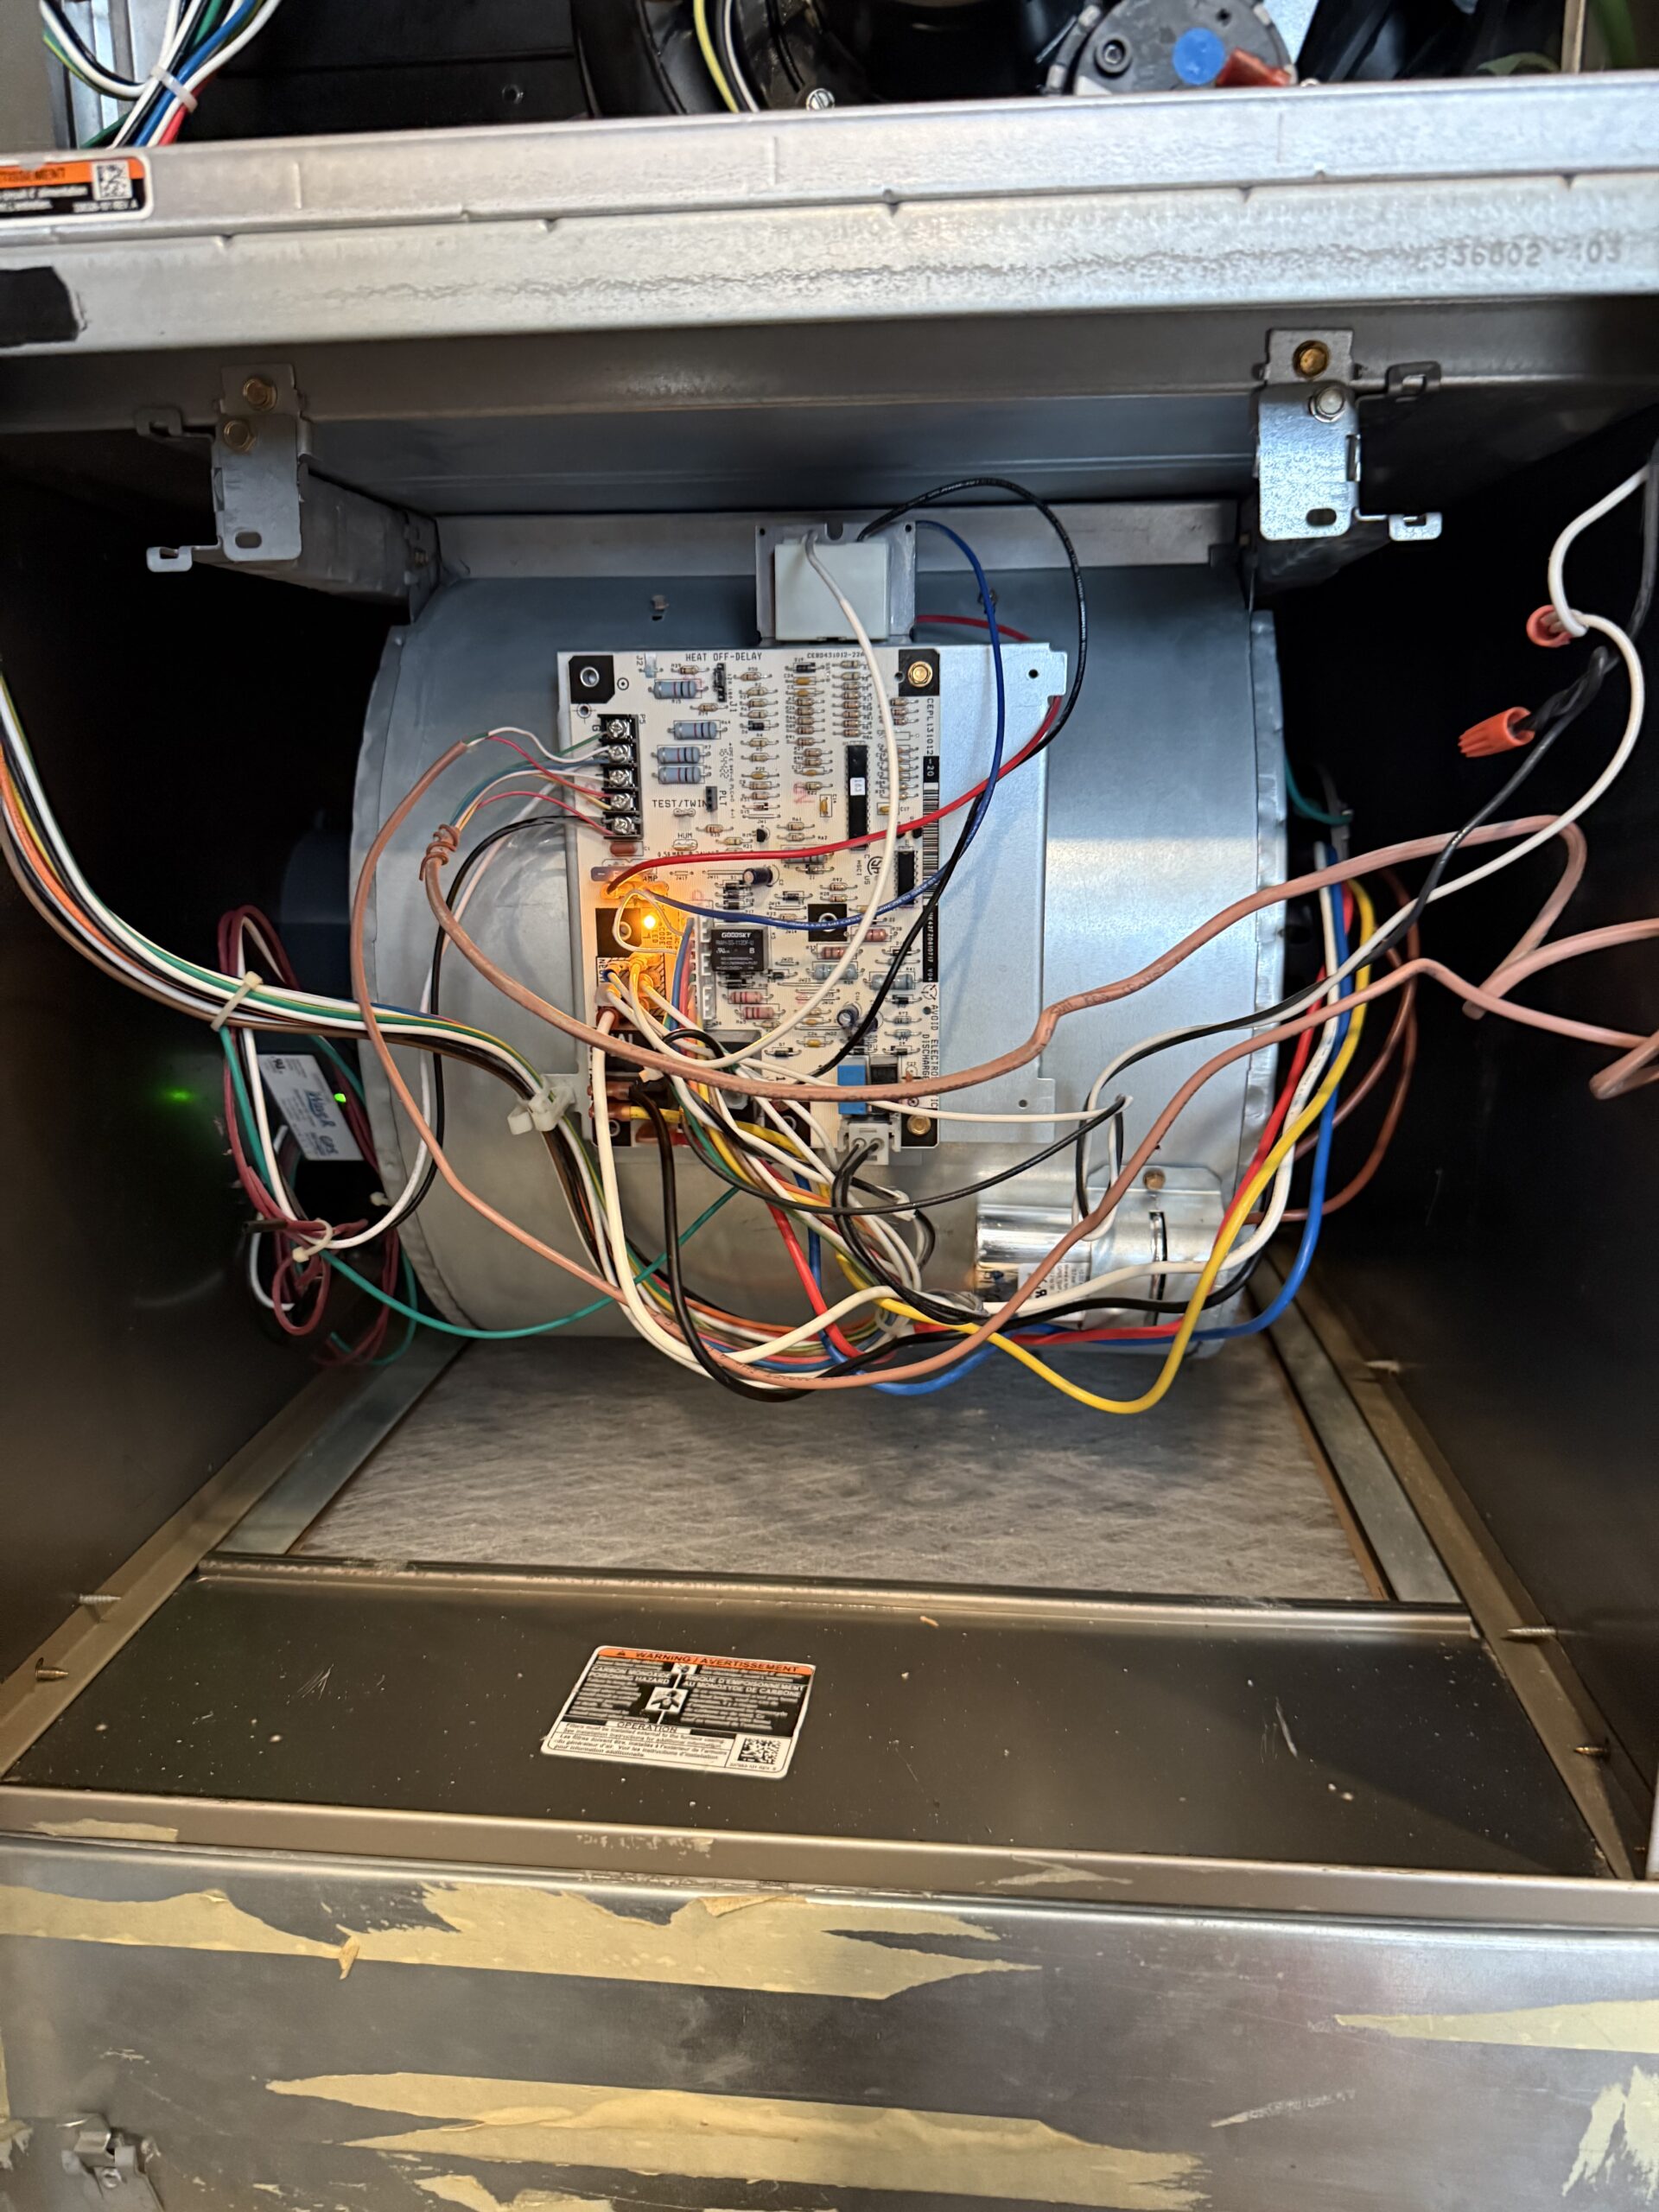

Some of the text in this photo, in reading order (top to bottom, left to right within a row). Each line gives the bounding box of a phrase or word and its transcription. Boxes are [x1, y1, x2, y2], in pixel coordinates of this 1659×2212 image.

[636, 655, 644, 666] J2
[685, 652, 763, 661] HEAT OFF-DELAY
[719, 790, 728, 806] PLT
[636, 1651, 691, 1663] WARNING
[701, 1657, 799, 1673] AVERTISSEMENT
[617, 1720, 677, 1734] OPERATION
